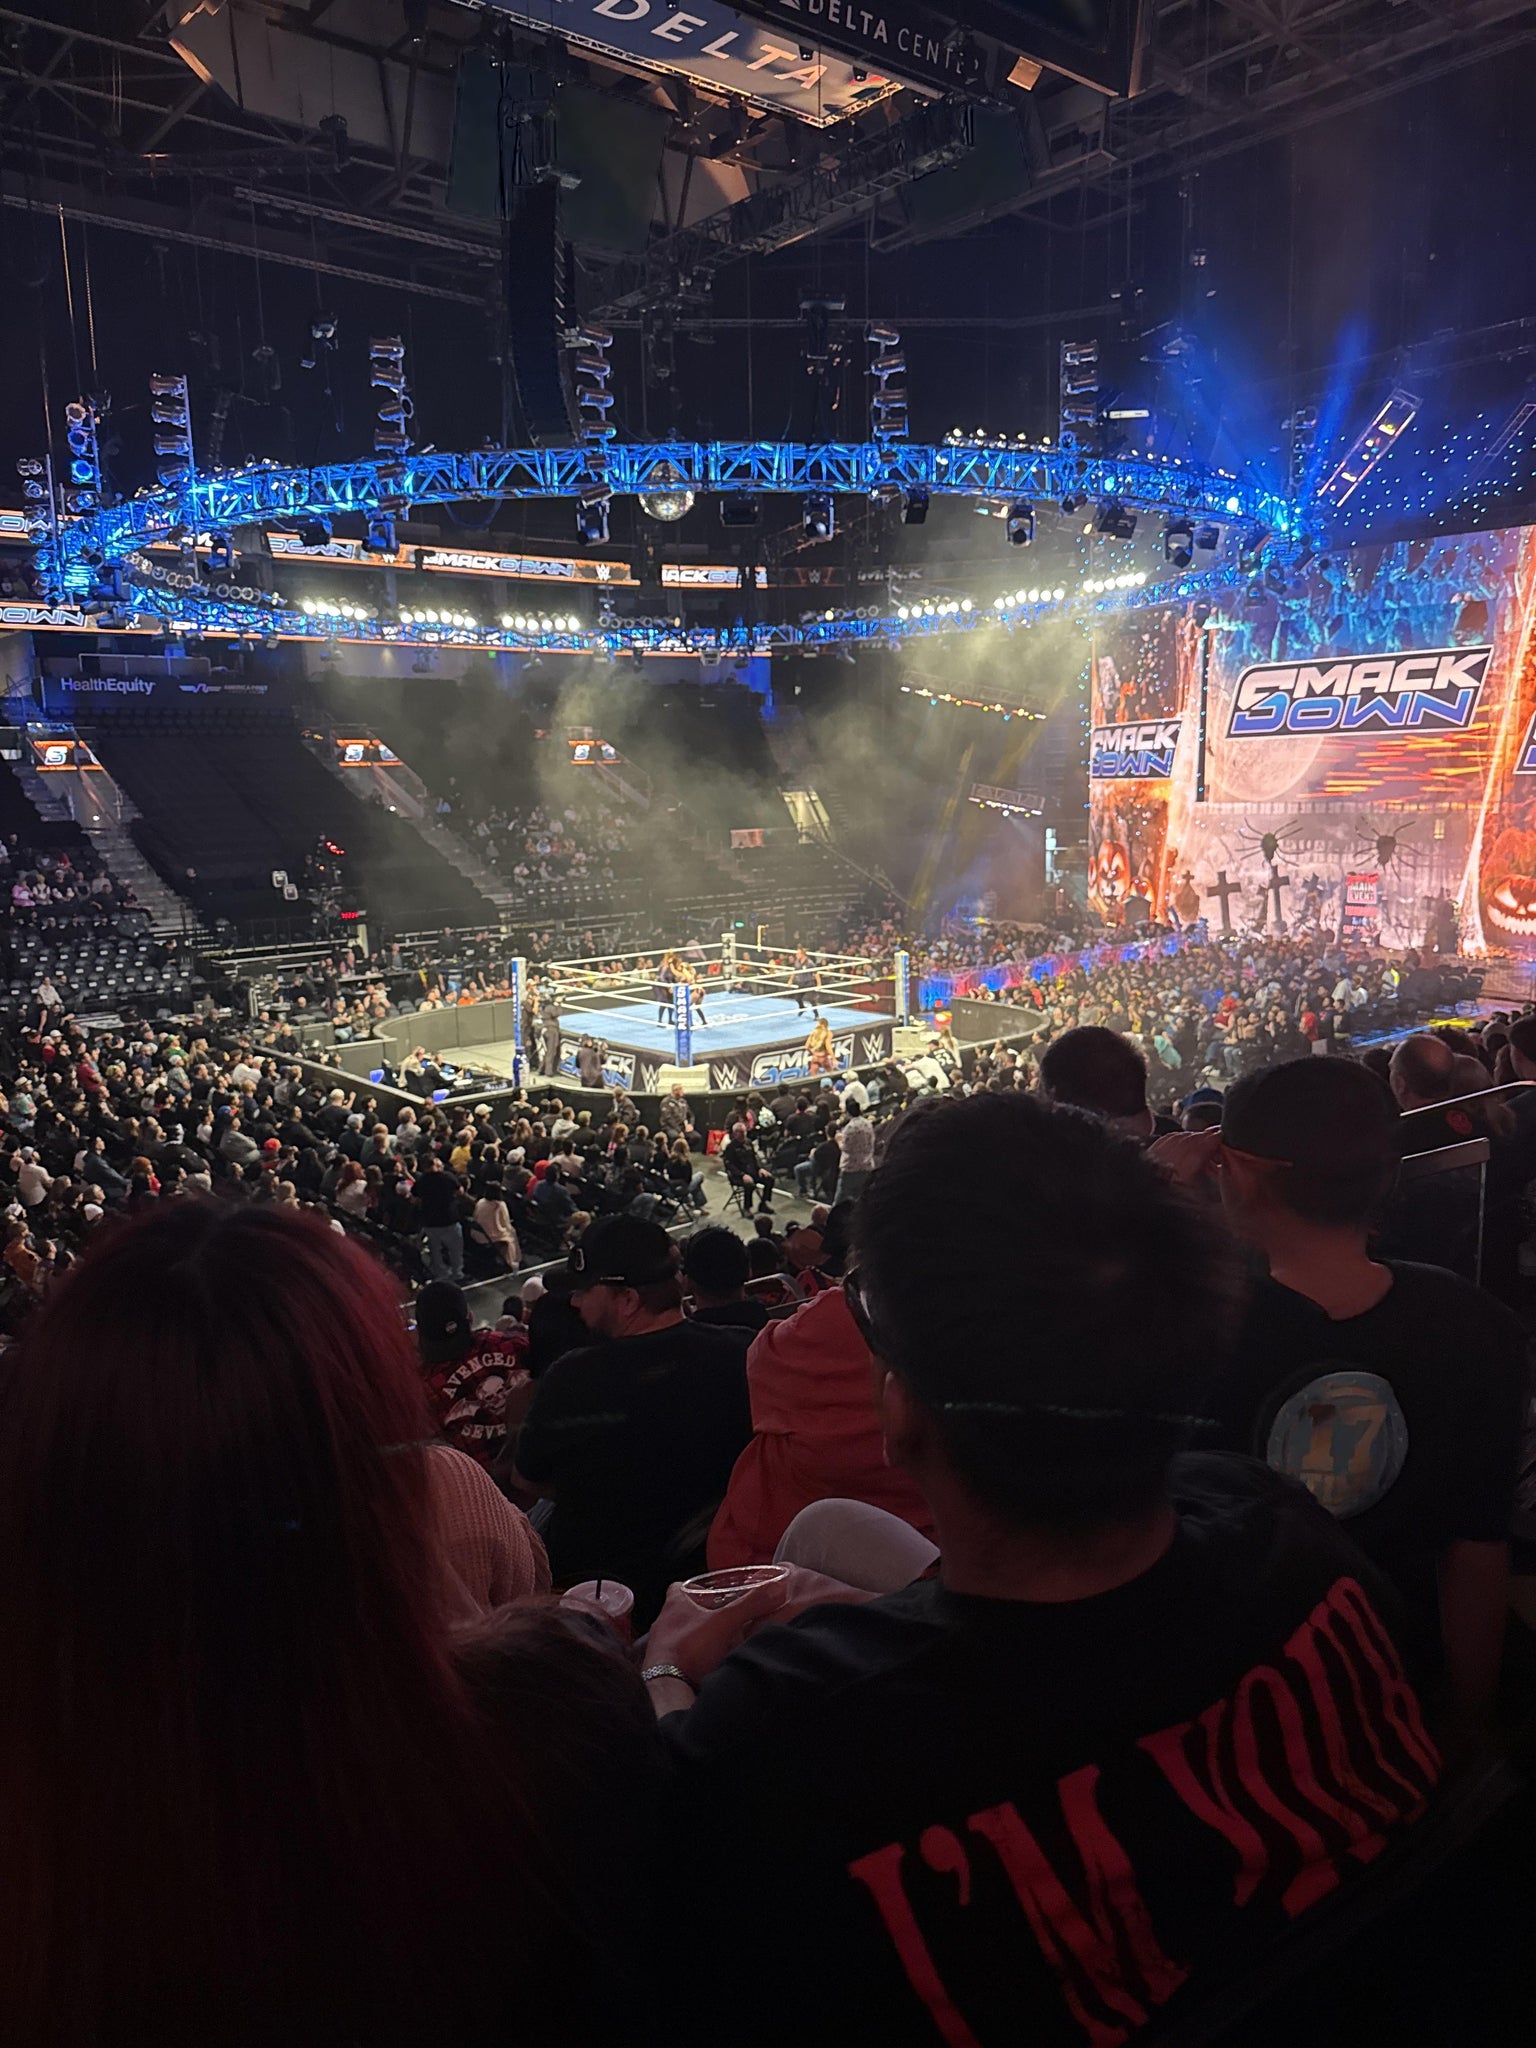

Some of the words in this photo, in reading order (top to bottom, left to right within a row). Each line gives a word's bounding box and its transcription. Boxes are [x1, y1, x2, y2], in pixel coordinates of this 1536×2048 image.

[592, 0, 828, 90] DELTA
[806, 0, 889, 45] DELTA
[897, 27, 979, 76] CENT
[61, 676, 154, 696] HealthEquity
[1237, 653, 1490, 711] SMACK
[1230, 688, 1475, 735] DOWN
[441, 1352, 517, 1400] AVENGED
[1300, 1403, 1388, 1475] 17
